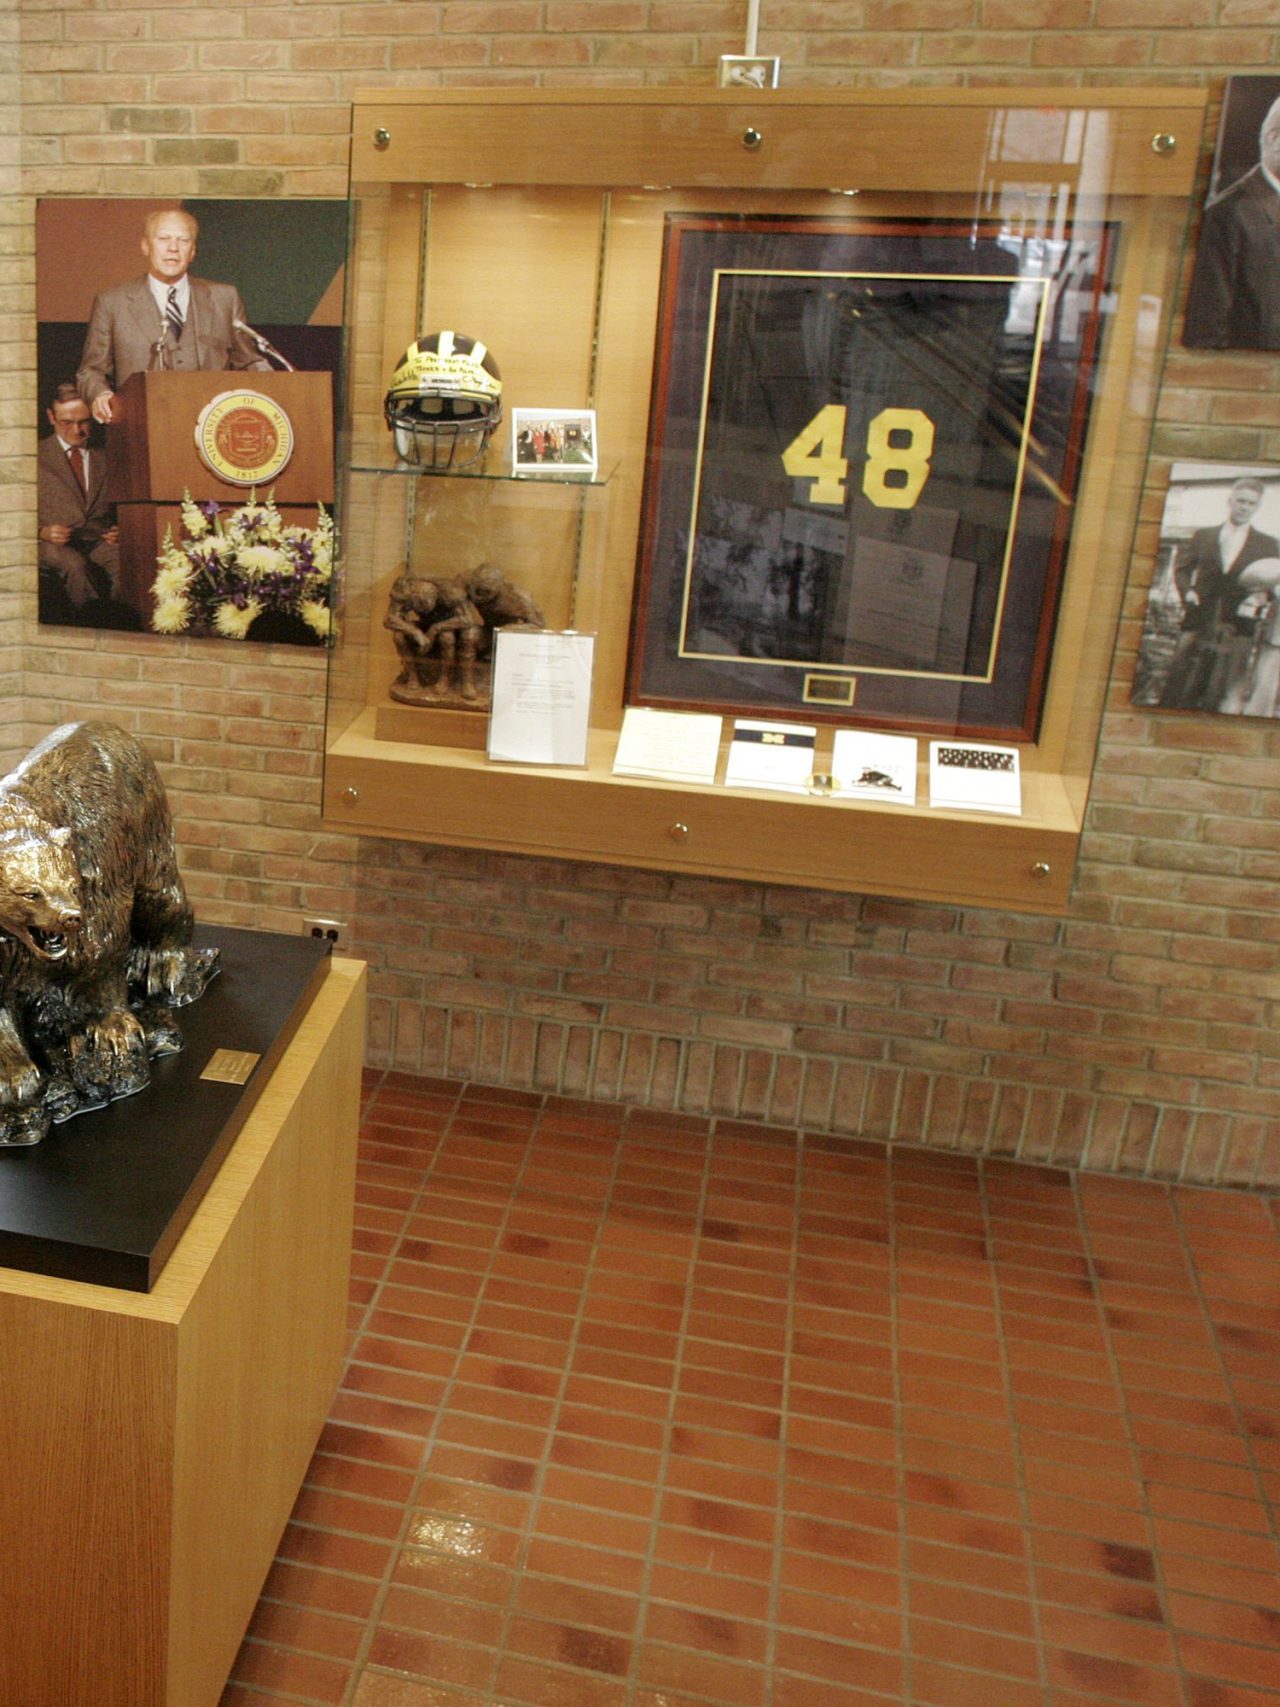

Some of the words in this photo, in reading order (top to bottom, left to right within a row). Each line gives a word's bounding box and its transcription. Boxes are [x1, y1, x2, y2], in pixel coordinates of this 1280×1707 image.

[203, 406, 224, 468] UNIVERSITY
[242, 397, 256, 405] OF
[272, 412, 290, 466] MICHIGAN
[781, 404, 936, 510] 48
